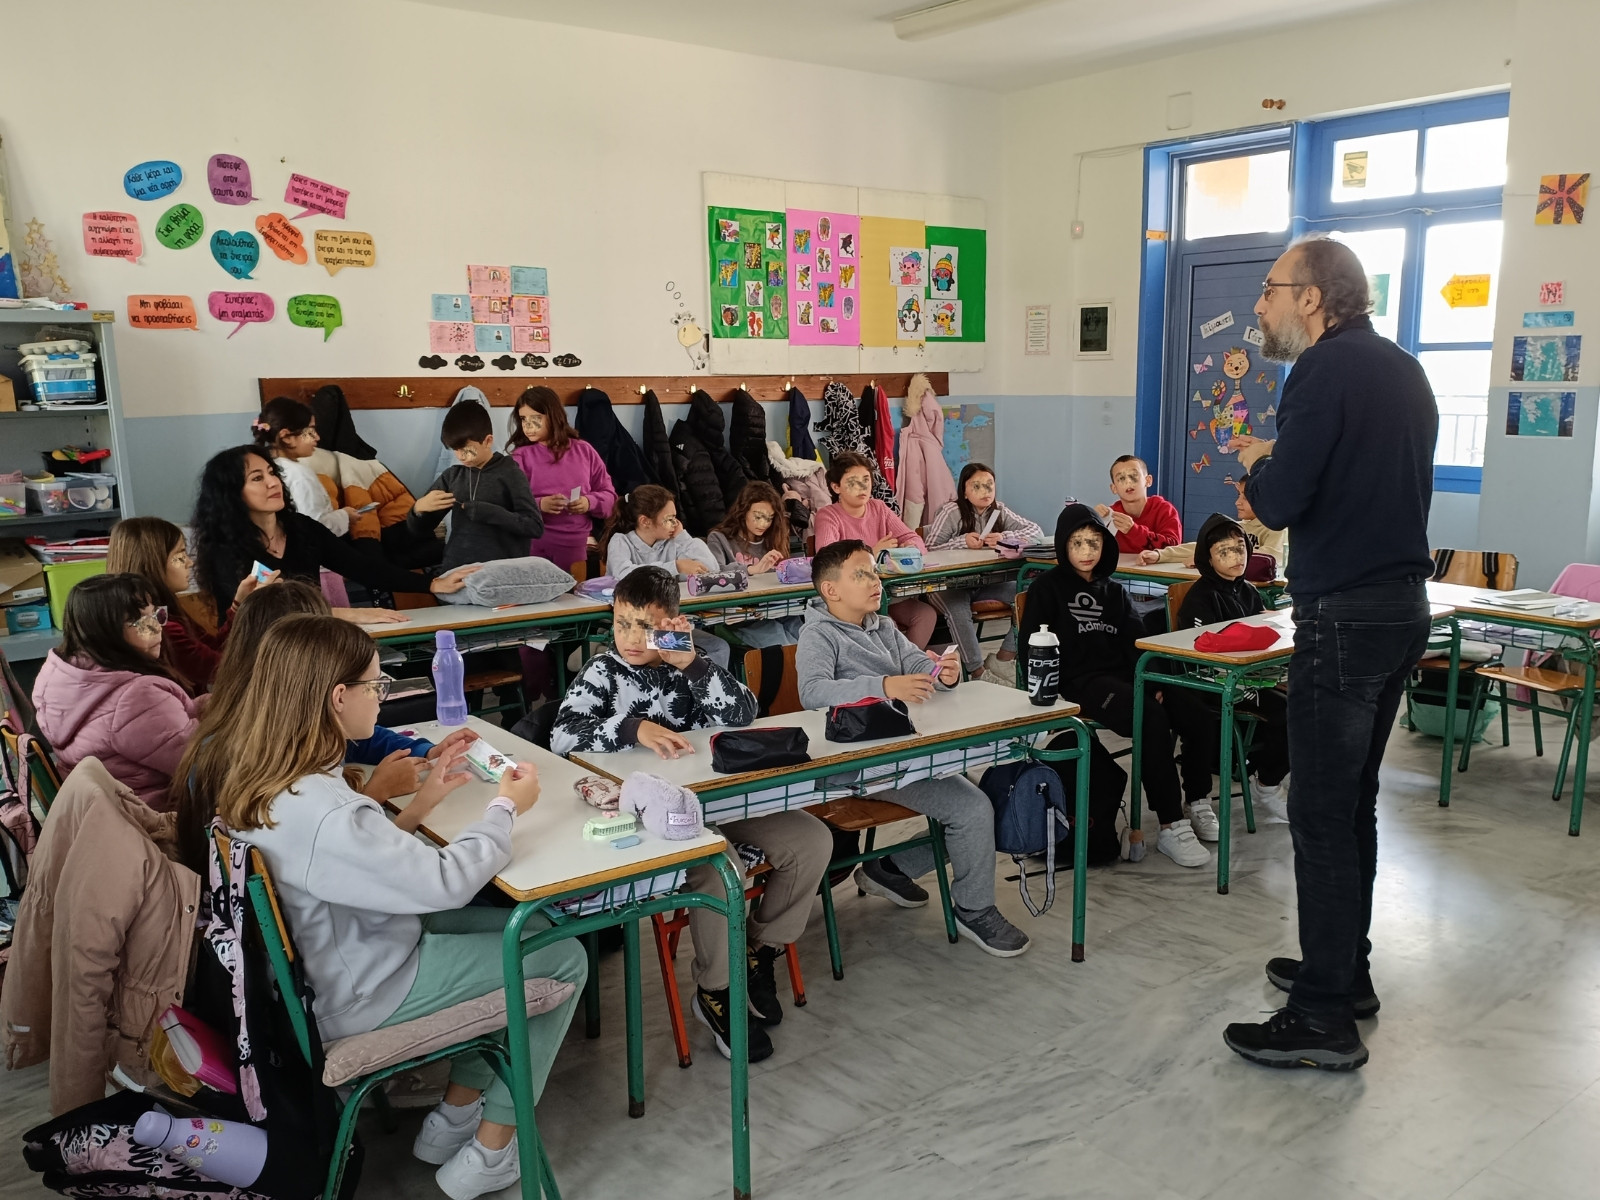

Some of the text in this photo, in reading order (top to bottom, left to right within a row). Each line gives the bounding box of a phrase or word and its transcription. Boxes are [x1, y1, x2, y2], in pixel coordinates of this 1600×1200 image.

[127, 166, 174, 184] Κάθε μέρα και
[222, 175, 238, 183] στον
[133, 178, 177, 198] μια νέα αρχή
[213, 187, 234, 197] εαυτό
[98, 236, 121, 246] αλλαγή
[153, 299, 183, 310] φοβάσαι
